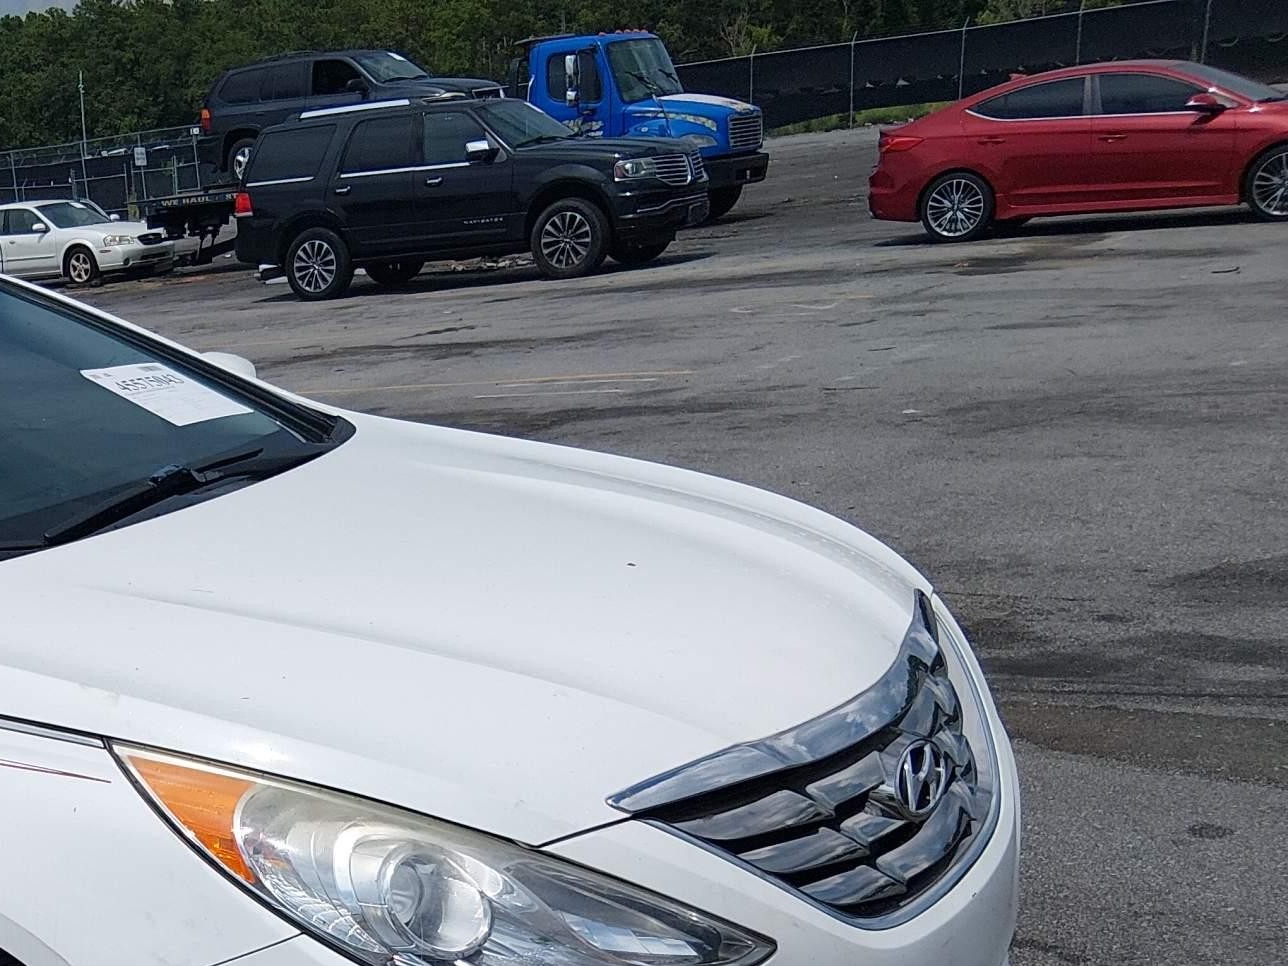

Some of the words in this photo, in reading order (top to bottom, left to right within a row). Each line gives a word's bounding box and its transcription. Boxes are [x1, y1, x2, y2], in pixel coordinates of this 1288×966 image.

[160, 199, 179, 207] WE
[182, 196, 210, 205] HAUL
[115, 374, 185, 392] 45575043
